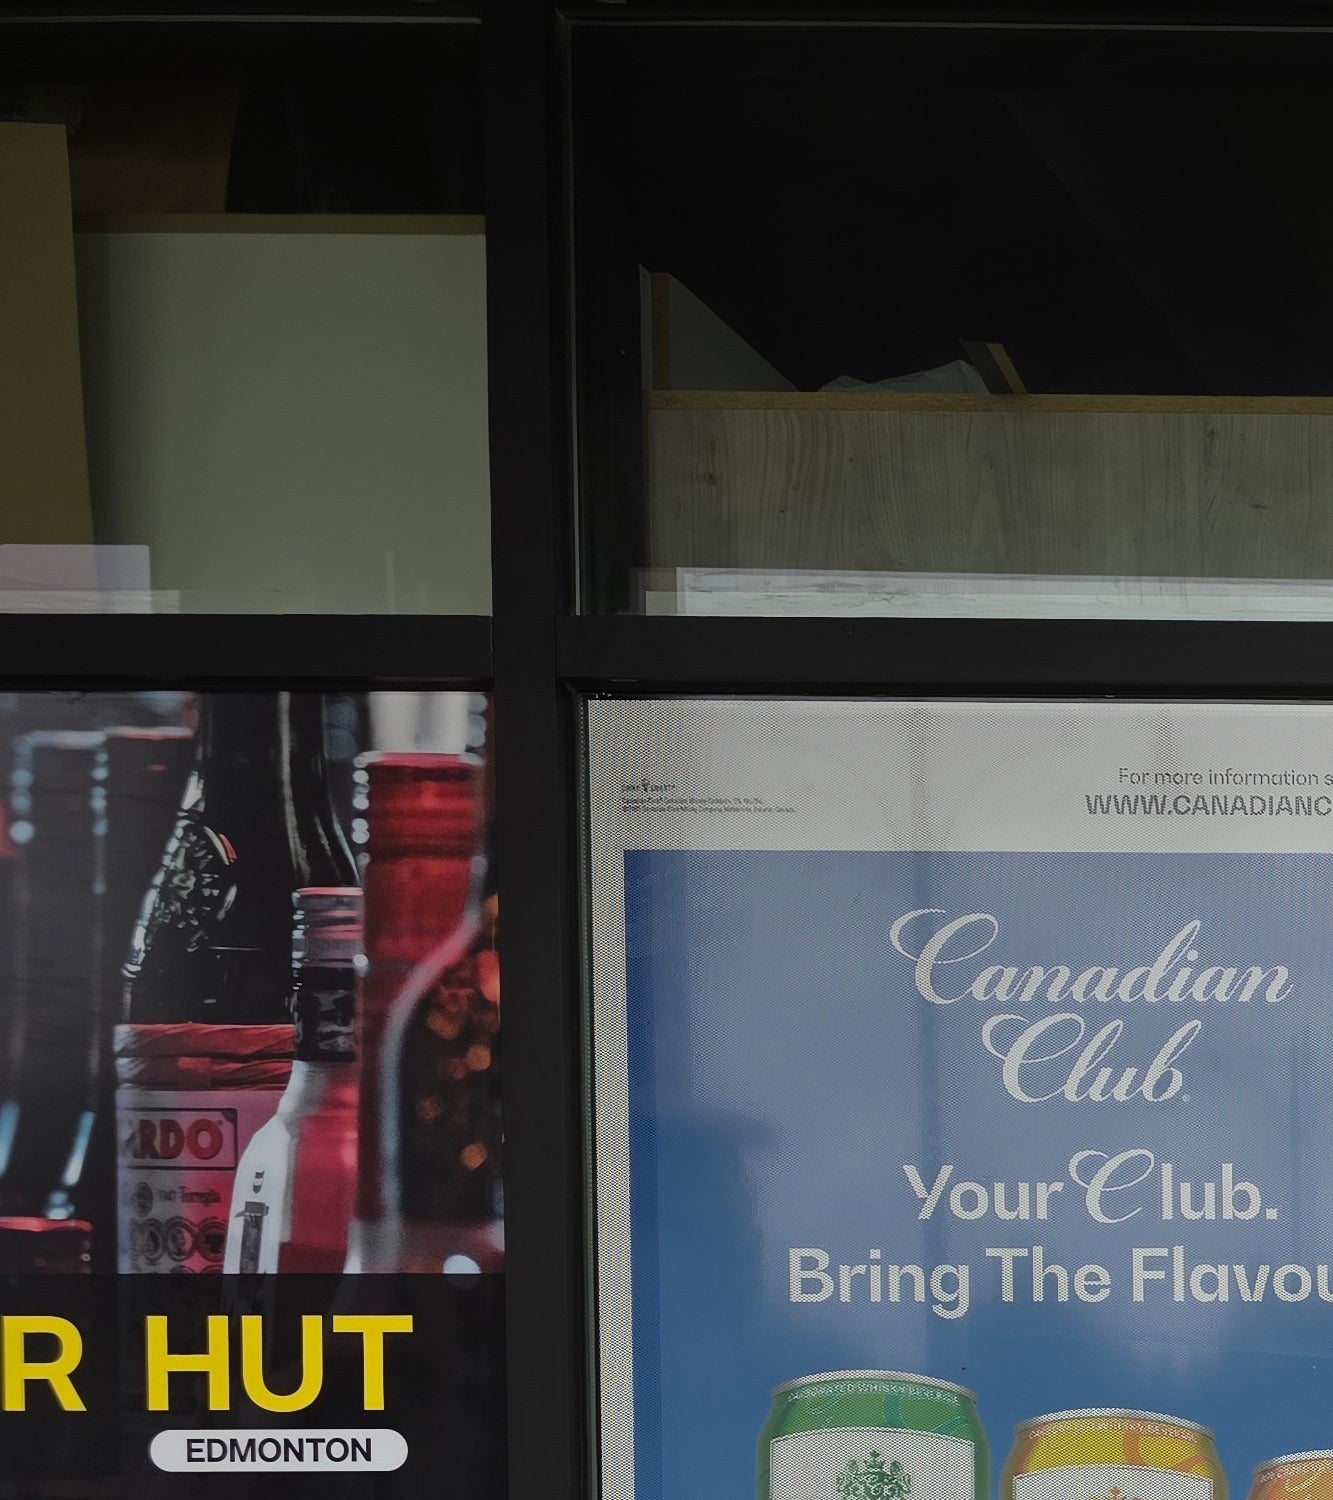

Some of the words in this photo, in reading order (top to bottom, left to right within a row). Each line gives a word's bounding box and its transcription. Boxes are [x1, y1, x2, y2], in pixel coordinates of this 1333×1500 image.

[1118, 767, 1150, 786] For
[1154, 771, 1204, 786] more
[1208, 767, 1319, 787] information
[889, 908, 1295, 1005] Canadian
[126, 1118, 224, 1161] RDO
[903, 1163, 1064, 1221] Your
[1068, 1148, 1279, 1224] Club.
[788, 1247, 970, 1320] Bring
[985, 1245, 1112, 1304] The
[1, 1315, 87, 1412] R
[146, 1315, 414, 1413] HUT
[186, 1437, 373, 1464] EDMONTON
